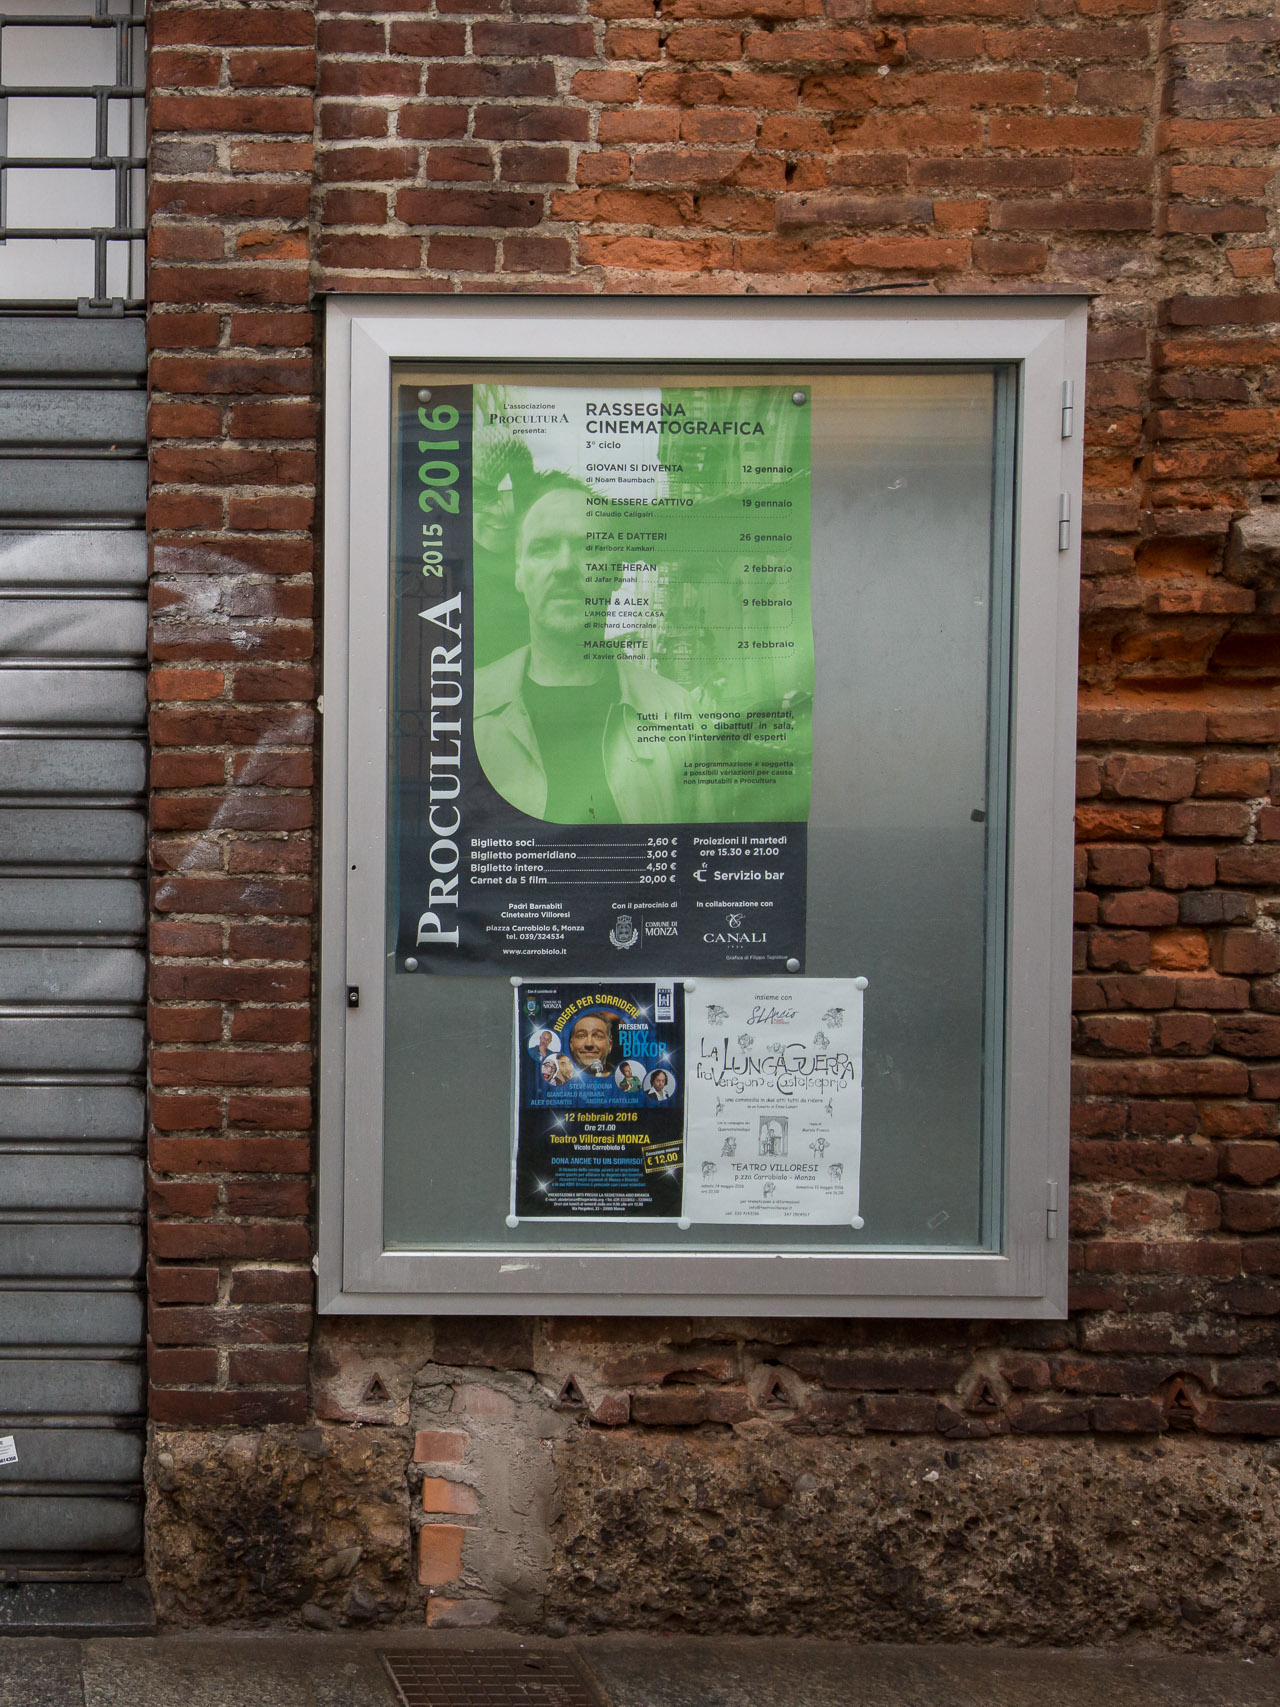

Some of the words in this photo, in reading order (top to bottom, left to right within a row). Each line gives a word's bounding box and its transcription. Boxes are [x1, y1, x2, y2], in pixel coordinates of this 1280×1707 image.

[586, 403, 686, 417] RASSEGNA
[489, 413, 569, 425] PROCULTURA
[586, 420, 765, 436] CINEMATOGRAFICA
[586, 441, 596, 449] 3°
[599, 441, 621, 449] ciclo
[418, 405, 460, 514] 2016
[586, 464, 627, 472] GIOVANI
[630, 464, 639, 472] SI
[642, 464, 683, 472] DIVENTA
[742, 465, 752, 473] 12
[755, 465, 793, 475] gennaio
[586, 498, 608, 506] NON
[611, 498, 648, 506] ESSERE
[651, 499, 694, 507] CATTIVO
[742, 500, 752, 508] 19
[755, 500, 793, 510] gennaio
[586, 532, 614, 540] PITZA
[618, 532, 624, 540] E
[627, 532, 667, 541] DATTERI
[754, 534, 793, 543] gennaio
[422, 524, 443, 577] 2015
[611, 564, 657, 572] TEHERAN
[744, 565, 750, 573] 2
[752, 565, 793, 573] febbraio
[585, 598, 611, 606] RUTH
[614, 598, 621, 606] &
[624, 598, 649, 606] ALEX
[743, 599, 749, 607] 9
[752, 598, 793, 607] febbraio
[584, 641, 648, 649] MARGUERITE
[737, 641, 749, 649] 23
[752, 640, 795, 649] febbraio
[637, 713, 658, 721] Tutti
[664, 712, 667, 721] i
[673, 712, 692, 720] film
[698, 712, 741, 721] vengono
[746, 710, 794, 720] presentati,
[637, 723, 694, 732] commentati
[714, 722, 753, 730] dibattuti
[758, 722, 767, 730] in
[773, 722, 794, 731] sala,
[637, 734, 666, 743] anche
[689, 733, 741, 742] l'intervento
[742, 733, 752, 741] di
[754, 733, 787, 743] esperti
[416, 591, 463, 948] PROCULTURA
[471, 838, 513, 849] Biglietto
[515, 838, 535, 847] soci
[648, 838, 669, 847] 2,60
[671, 837, 678, 846] €
[693, 837, 740, 846] Proiezioni
[742, 837, 748, 845] il
[750, 836, 787, 845] martedì
[471, 851, 513, 861] Biglietto
[515, 851, 576, 860] pomeridiano
[647, 850, 668, 859] 3,00
[670, 850, 677, 858] €
[717, 848, 742, 856] 15.30
[753, 848, 779, 856] 21.00
[470, 864, 512, 873] Biglietto
[515, 864, 544, 872] intero
[646, 863, 668, 872] 4,50
[670, 863, 677, 871] €
[470, 876, 502, 885] Carnet
[505, 876, 517, 884] da
[520, 876, 526, 884] 5
[529, 876, 547, 884] film
[639, 875, 667, 884] 20,00
[669, 875, 676, 883] €
[714, 871, 762, 881] Servizio
[764, 870, 785, 880] bar
[634, 902, 669, 910] patrocinio
[486, 925, 510, 933] piazza
[645, 927, 678, 936] MONZA
[519, 933, 564, 941] 039/324534
[703, 933, 767, 943] CANALI
[554, 1003, 578, 1032] RIDERE
[576, 995, 594, 1009] PER
[595, 994, 641, 1020] SORRIDERE
[619, 1031, 649, 1045] RIKY
[723, 1038, 788, 1076] LUNGA
[785, 1043, 854, 1080] GUERRA
[565, 1113, 575, 1122] 12
[577, 1113, 614, 1122] febbraio
[616, 1113, 638, 1121] 2016
[550, 1135, 577, 1144] Teatro
[579, 1134, 615, 1144] Villoresi
[617, 1134, 650, 1144] MONZA
[647, 1157, 653, 1165] €
[654, 1152, 678, 1165] 12.00
[731, 1163, 767, 1172] TEATRO
[770, 1163, 819, 1172] VILLORESI
